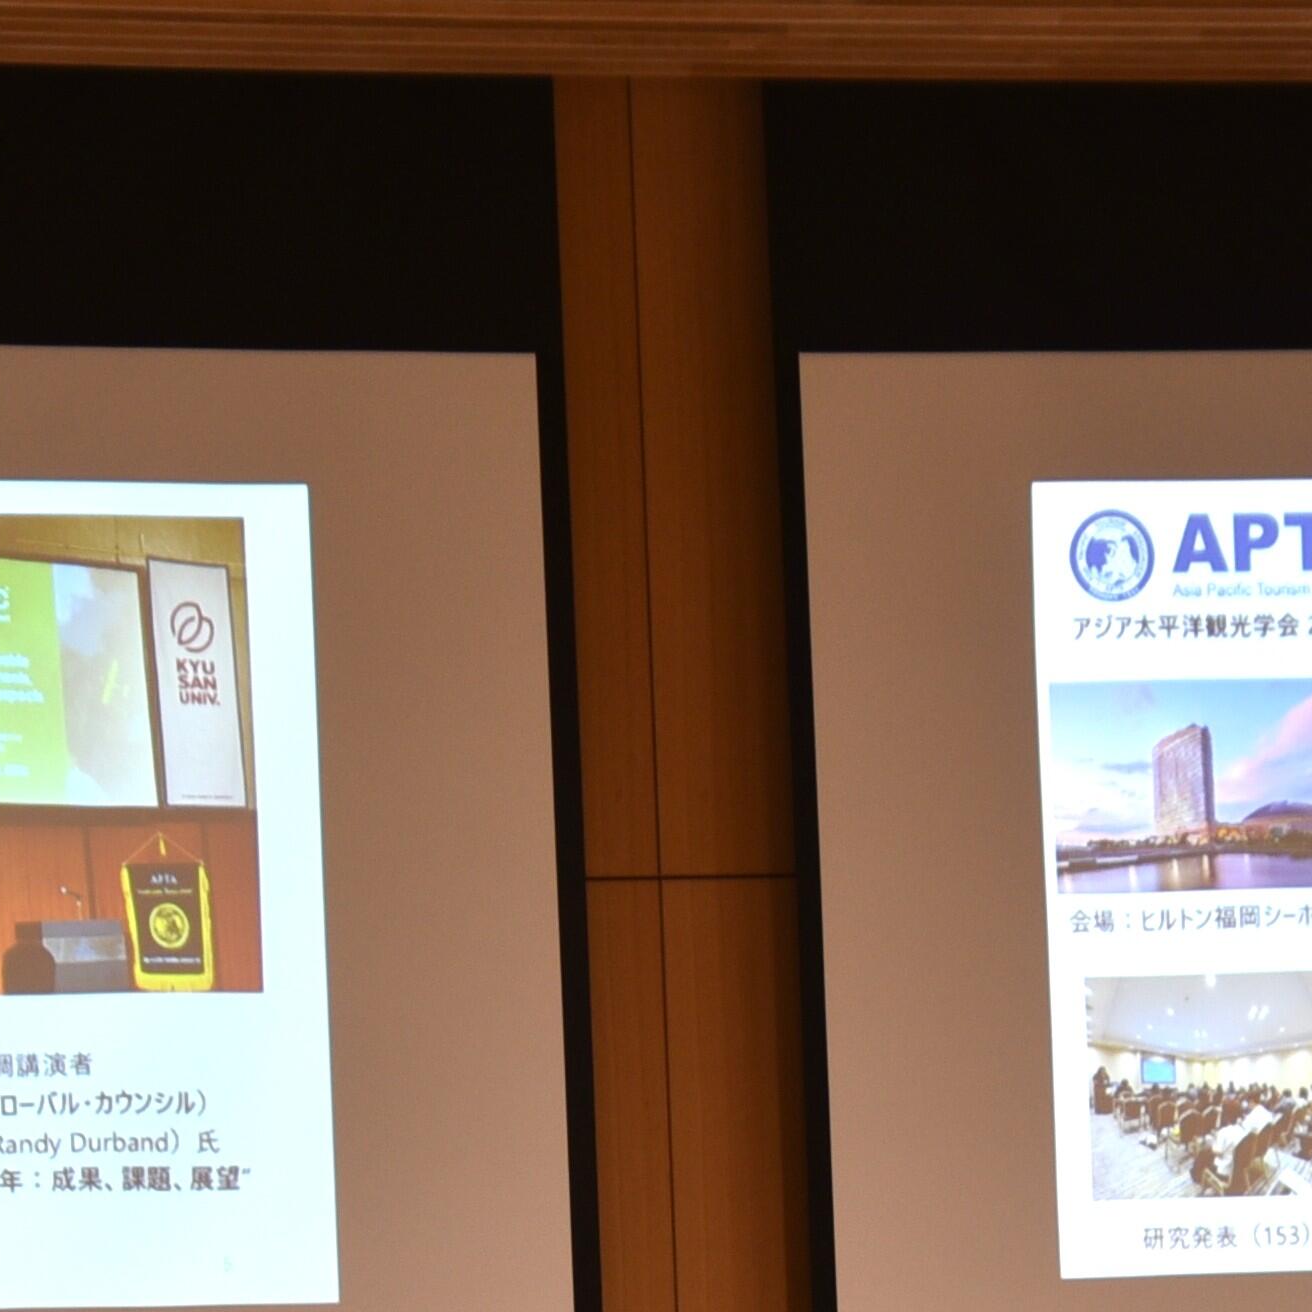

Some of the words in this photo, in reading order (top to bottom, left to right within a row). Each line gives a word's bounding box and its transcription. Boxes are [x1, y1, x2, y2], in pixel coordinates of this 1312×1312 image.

[1172, 583, 1202, 598] Asia
[1207, 582, 1252, 598] Pacific
[1258, 581, 1310, 597] Tourism
[1074, 613, 1299, 639] アジア太平洋観光学会
[176, 658, 215, 675] KYU
[178, 675, 217, 690] SAN
